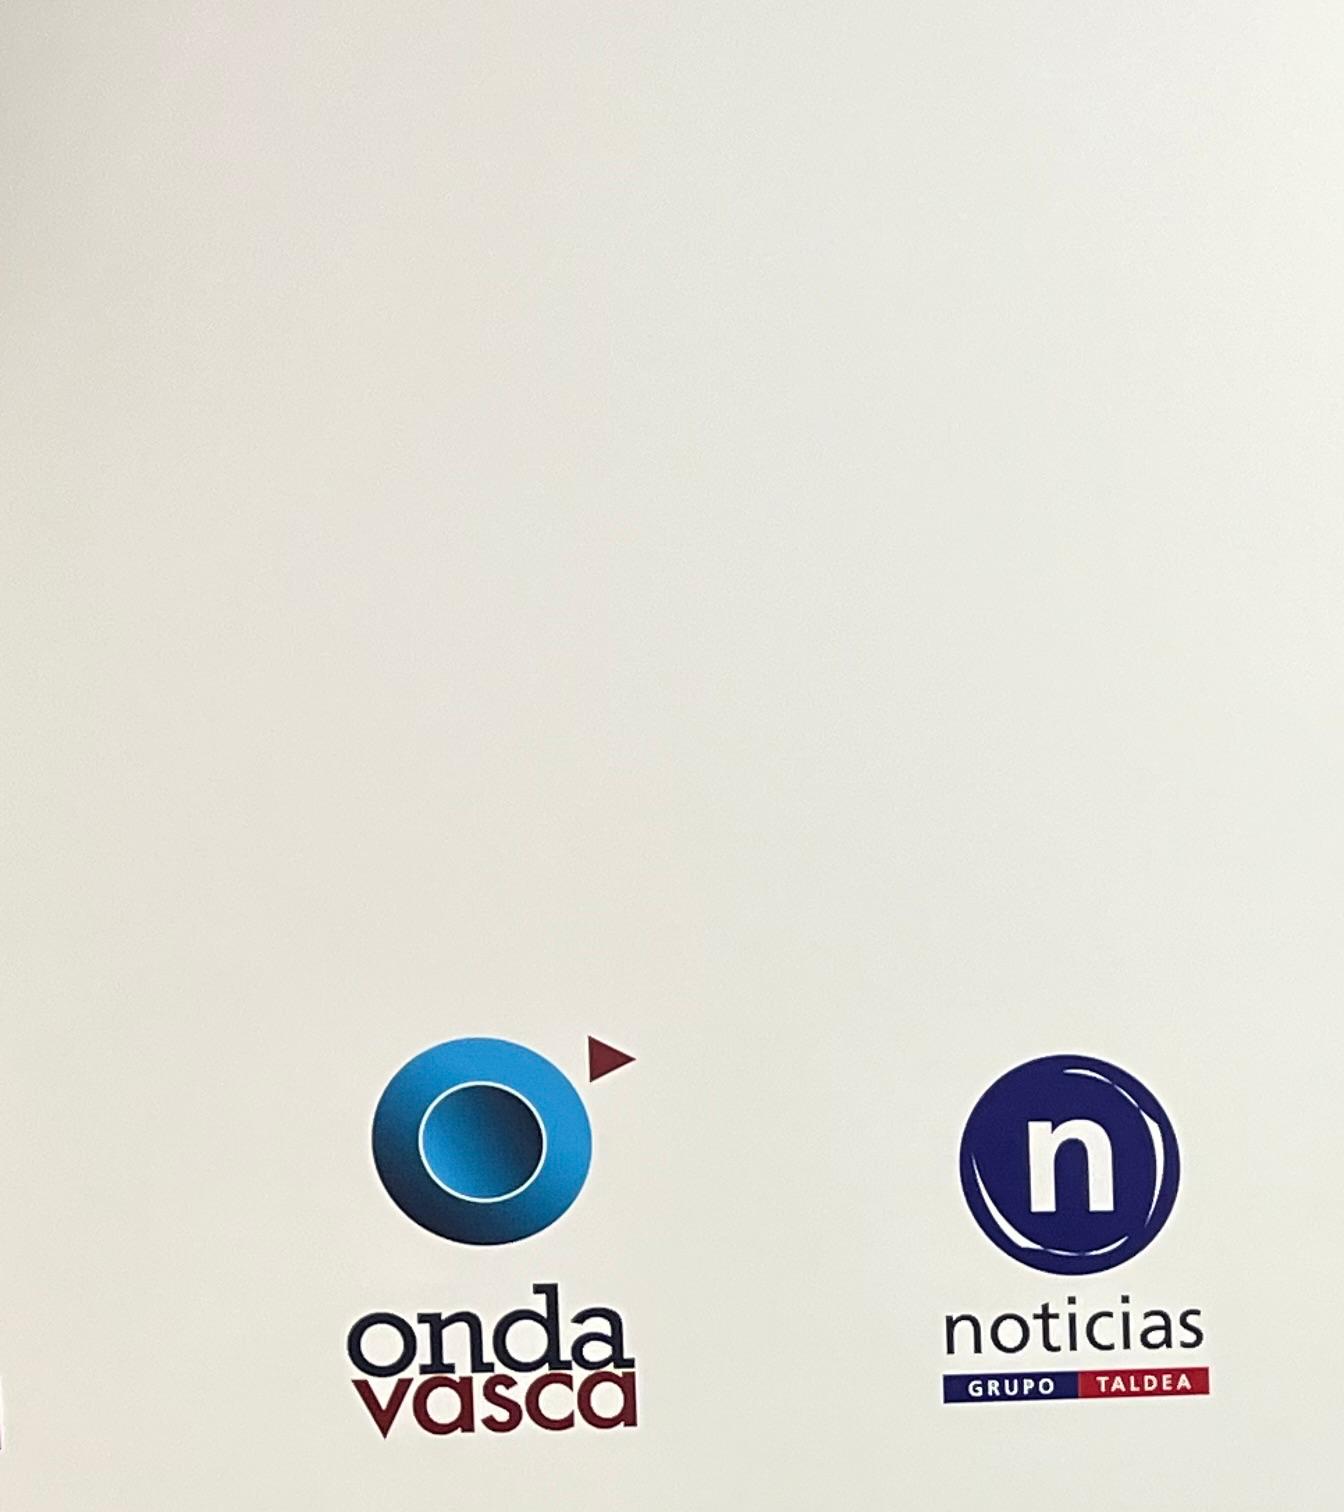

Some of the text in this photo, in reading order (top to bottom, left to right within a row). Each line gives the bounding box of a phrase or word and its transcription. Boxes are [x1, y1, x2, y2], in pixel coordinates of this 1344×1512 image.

[347, 1283, 636, 1378] onda
[944, 1295, 1204, 1355] noticias
[353, 1367, 637, 1438] vasca
[968, 1374, 1192, 1397] GRUPO TALDEA
